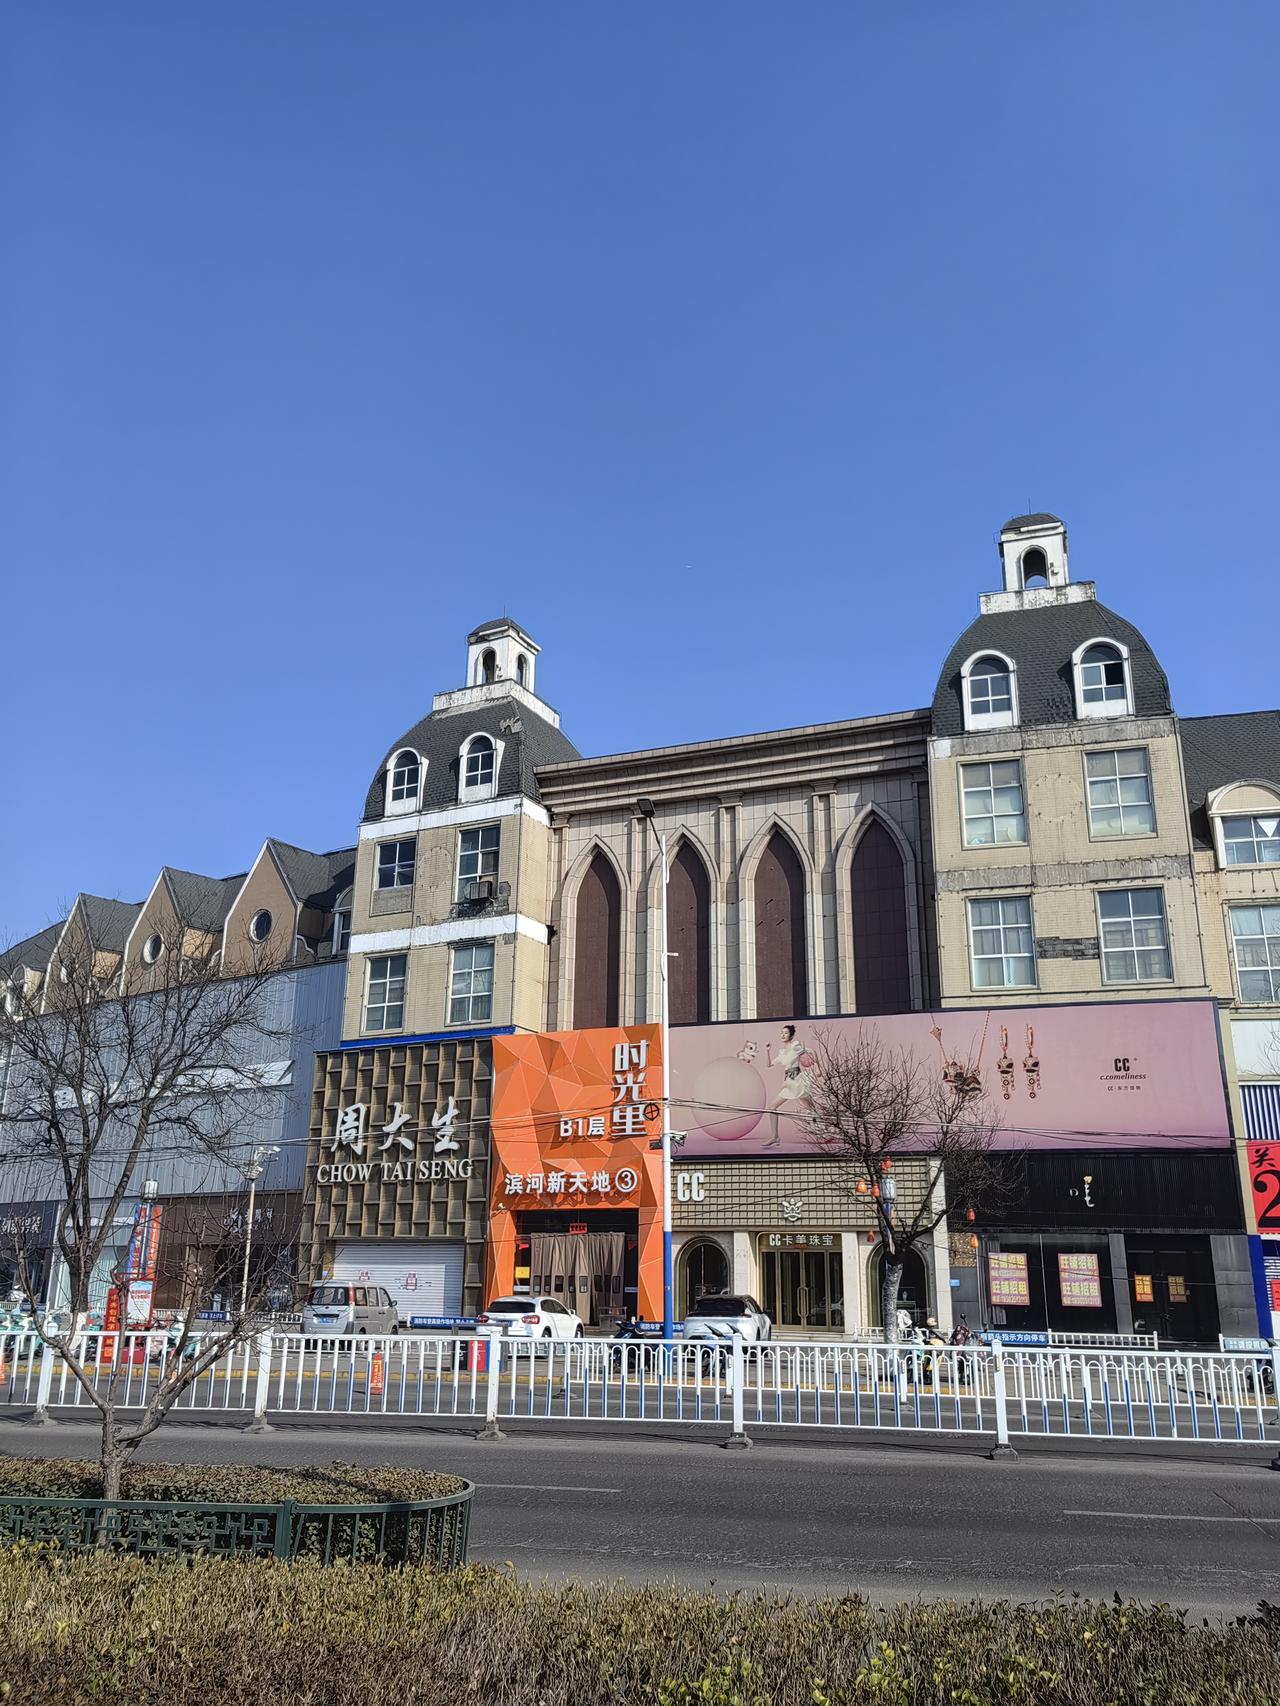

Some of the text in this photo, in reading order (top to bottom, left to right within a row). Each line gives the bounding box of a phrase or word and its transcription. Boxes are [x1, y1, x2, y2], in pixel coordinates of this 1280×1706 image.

[1114, 1058, 1130, 1072] CC
[610, 1039, 649, 1136] 时光里
[330, 1096, 461, 1155] 周大生
[559, 1116, 605, 1137] B1层
[317, 1158, 473, 1183] CHOW TAI SENG
[677, 1172, 705, 1202] CC
